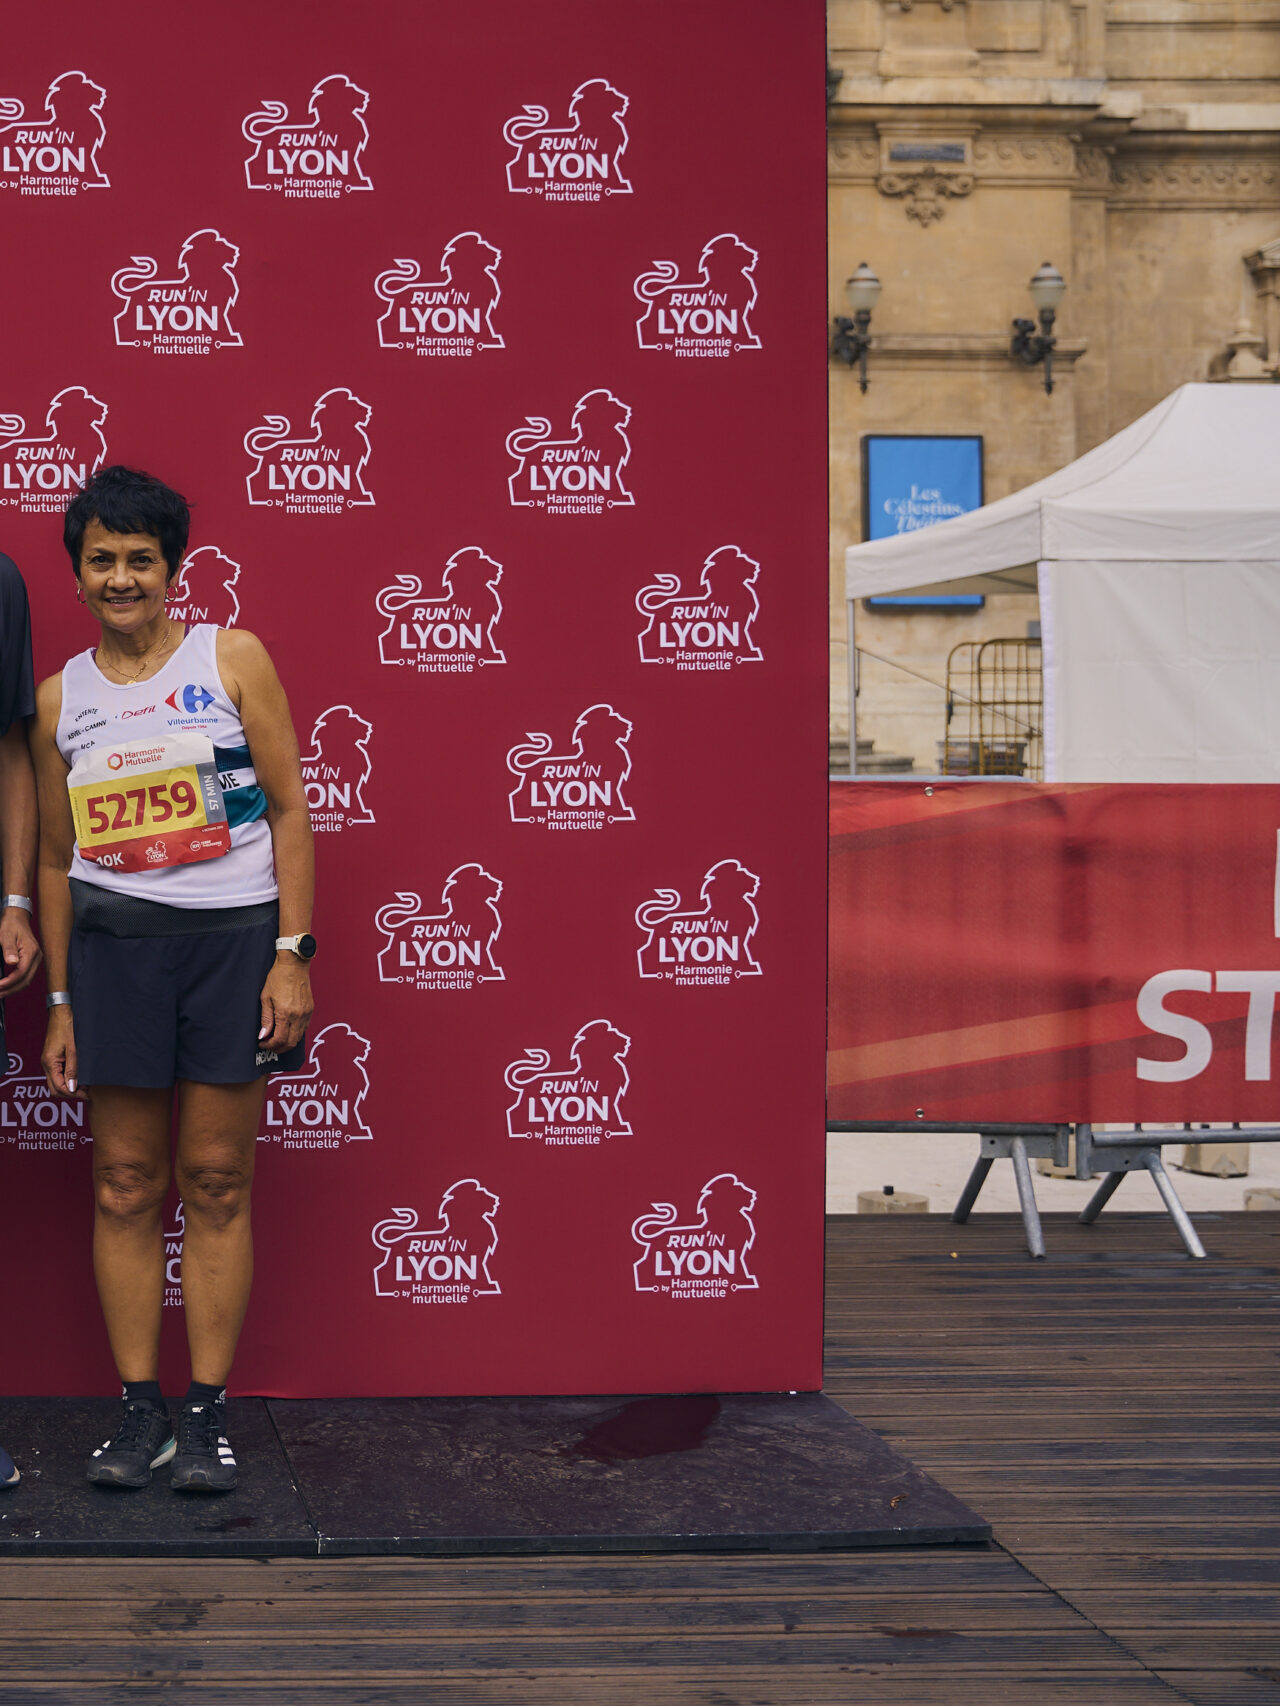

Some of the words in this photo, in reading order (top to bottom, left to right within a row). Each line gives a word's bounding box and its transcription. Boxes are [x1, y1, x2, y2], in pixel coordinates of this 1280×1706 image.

[278, 131, 338, 147] RUN'IN
[539, 134, 597, 150] RUN'IN
[267, 149, 348, 175] LYON
[528, 153, 608, 178] LYON
[273, 183, 283, 192] by
[284, 177, 342, 188] Harmonie
[534, 186, 544, 195] by
[545, 181, 602, 191] Harmonie
[285, 188, 340, 199] mutuelle
[546, 192, 600, 201] mutuelle
[148, 286, 207, 302] RUN'IN
[669, 290, 727, 306] RUN'IN
[136, 305, 218, 331] LYON
[658, 309, 737, 334] LYON
[142, 339, 152, 349] by
[153, 334, 212, 344] Harmonie
[154, 344, 209, 355] mutuelle
[664, 342, 674, 351] by
[675, 337, 732, 347] Harmonie
[676, 347, 729, 357] mutuelle
[15, 444, 75, 460] RUN'IN
[280, 445, 340, 461] RUN'IN
[4, 463, 86, 489] LYON
[269, 464, 350, 490] LYON
[275, 498, 285, 508] by
[286, 493, 344, 503] Harmonie
[911, 485, 941, 501] Les
[287, 504, 342, 513] mutuelle
[412, 604, 471, 620] RUN'IN
[671, 602, 729, 619] RUN'IN
[401, 623, 481, 649] LYON
[660, 621, 739, 647] LYON
[406, 657, 417, 667] by
[417, 652, 475, 662] Harmonie
[665, 656, 676, 665] by
[676, 650, 733, 660] Harmonie
[677, 660, 731, 670] mutuelle
[418, 663, 473, 672] mutuelle
[74, 707, 99, 722] ENTENTE
[167, 716, 219, 727] Villeurbanne
[124, 745, 166, 759] Harmonie
[125, 754, 162, 767] Mutuelle
[542, 761, 601, 778] RUN'IN
[204, 774, 217, 797] MIN
[531, 781, 611, 807] LYON
[86, 780, 197, 835] 52759
[208, 798, 219, 811] 57
[536, 815, 547, 824] by
[548, 809, 605, 819] Harmonie
[548, 820, 603, 830] mutuelle
[411, 921, 470, 938] RUN'IN
[400, 940, 480, 966] LYON
[405, 975, 415, 984] by
[416, 969, 474, 979] Harmonie
[417, 979, 472, 989] mutuelle
[278, 1081, 338, 1097] RUN'IN
[540, 1077, 599, 1094] RUN'IN
[267, 1100, 348, 1125] LYON
[529, 1096, 608, 1122] LYON
[272, 1134, 282, 1143] by
[284, 1128, 342, 1138] Harmonie
[534, 1131, 544, 1140] by
[545, 1124, 602, 1135] Harmonie
[545, 1135, 600, 1145] mutuelle
[284, 1139, 339, 1148] mutuelle
[667, 1231, 725, 1248] RUN'IN
[655, 1250, 735, 1276] LYON
[661, 1284, 671, 1293] by
[672, 1278, 728, 1288] Harmonie
[672, 1288, 726, 1298] mutuelle
